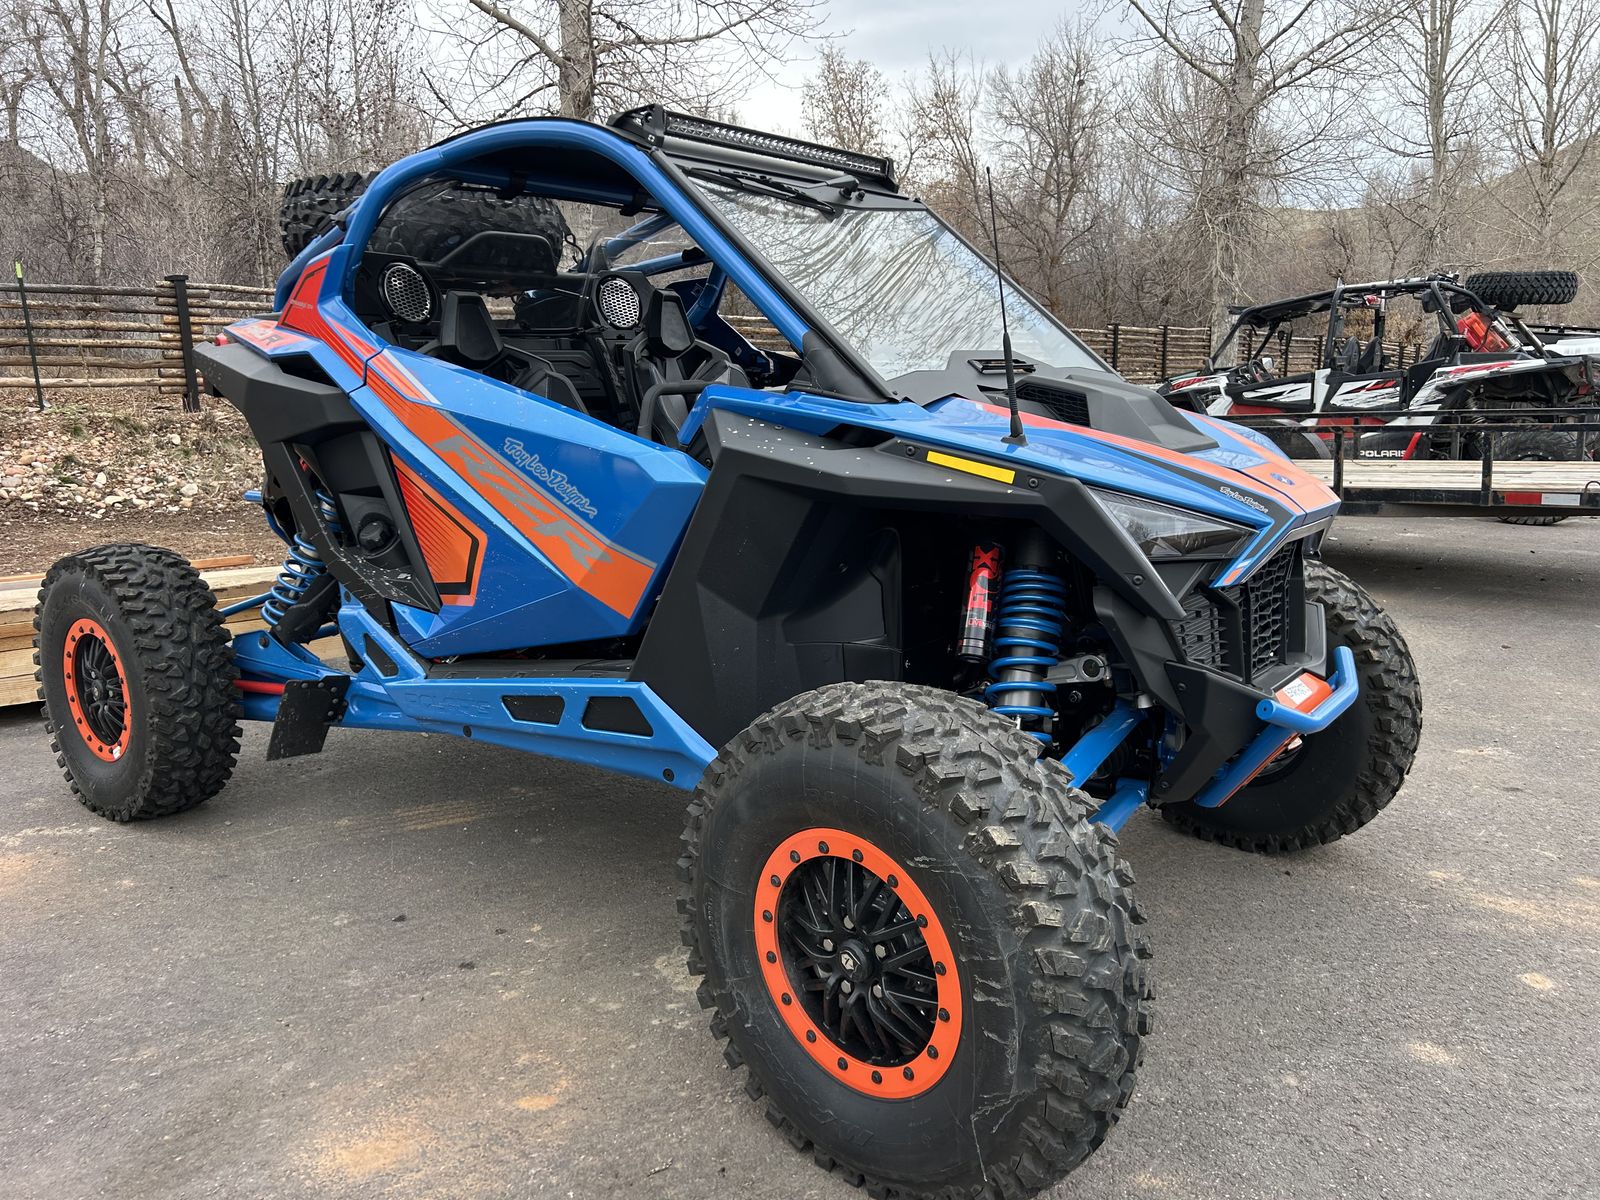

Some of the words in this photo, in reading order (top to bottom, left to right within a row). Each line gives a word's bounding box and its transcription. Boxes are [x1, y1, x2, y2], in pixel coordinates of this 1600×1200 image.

[503, 437, 530, 467] Troy
[525, 454, 549, 481] Lee
[547, 469, 598, 519] Designs
[1360, 450, 1406, 458] POLARIS
[432, 435, 614, 574] RZR
[967, 545, 1000, 612] FOX
